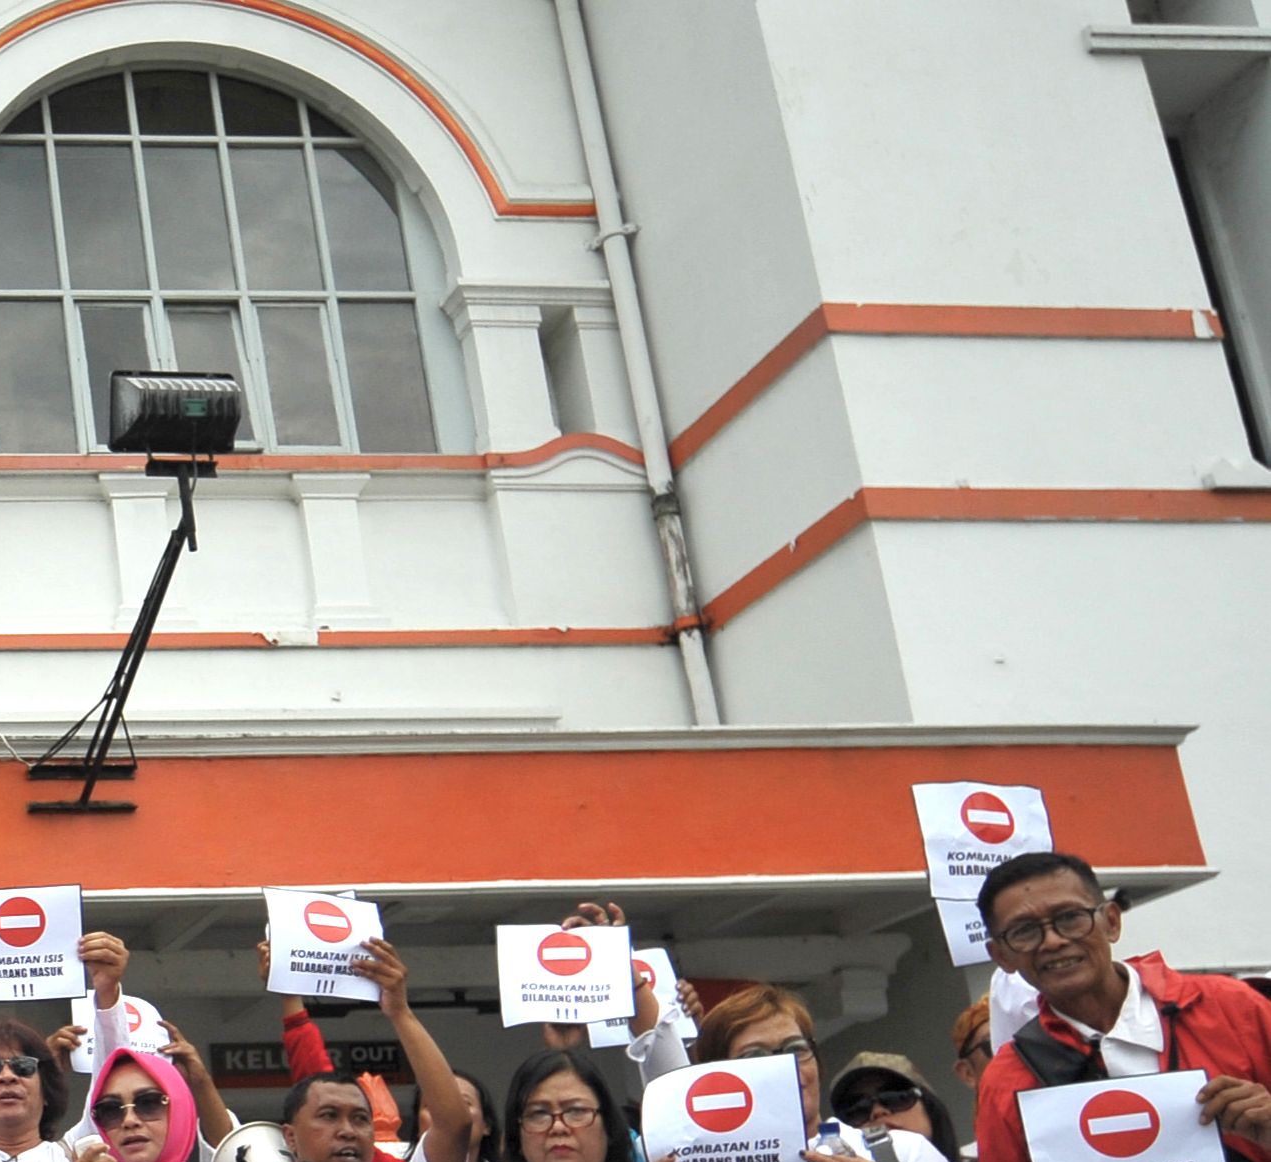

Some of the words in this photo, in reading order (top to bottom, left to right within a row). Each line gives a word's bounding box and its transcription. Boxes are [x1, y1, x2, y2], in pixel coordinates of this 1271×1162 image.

[44, 954, 63, 963] ISIS
[290, 949, 347, 962] KOMBATAN
[29, 967, 63, 977] MASUK
[290, 961, 333, 975] DILARANG
[521, 983, 586, 991] KOMBATAN
[590, 984, 611, 992] ISIS
[522, 993, 571, 1003] DILARANG
[351, 1046, 396, 1061] OUT
[671, 1141, 750, 1159] KOMBATAN
[754, 1138, 780, 1150] ISIS
